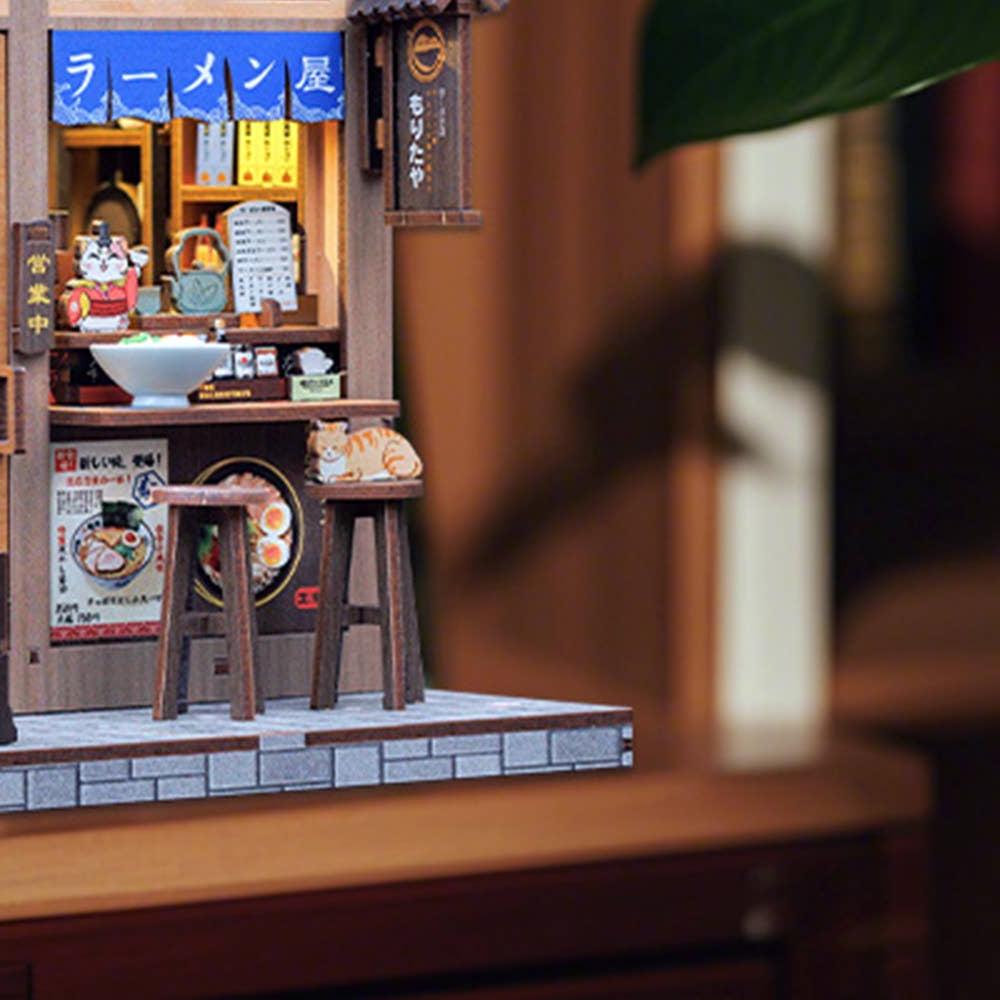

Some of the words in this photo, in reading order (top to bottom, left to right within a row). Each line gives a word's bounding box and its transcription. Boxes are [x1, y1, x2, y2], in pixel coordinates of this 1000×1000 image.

[66, 52, 336, 98] ラーメン屋
[409, 94, 424, 188] もりたや
[26, 253, 51, 335] 営業中
